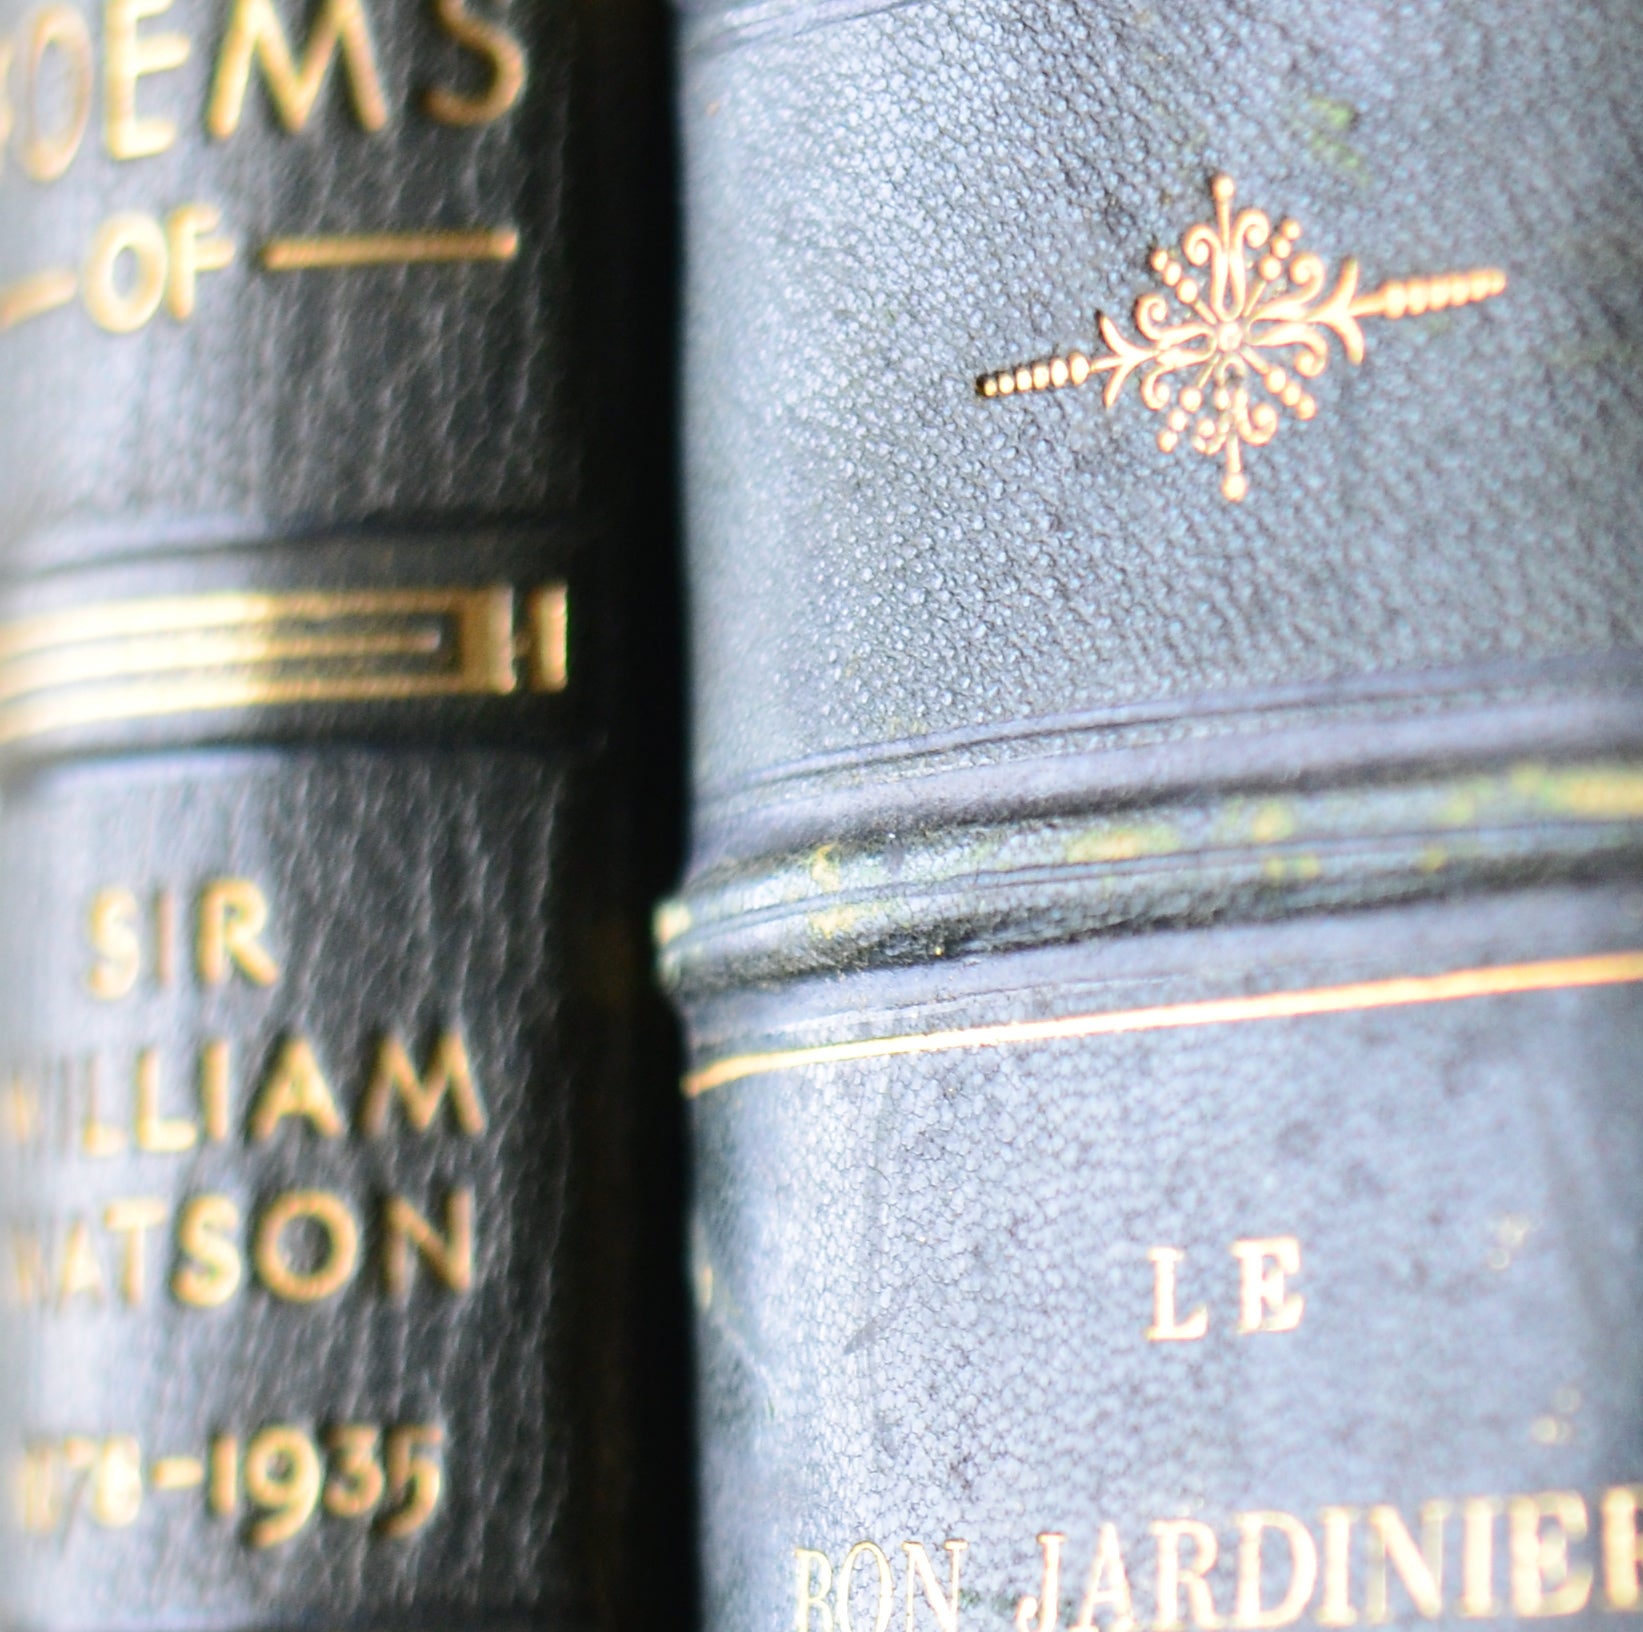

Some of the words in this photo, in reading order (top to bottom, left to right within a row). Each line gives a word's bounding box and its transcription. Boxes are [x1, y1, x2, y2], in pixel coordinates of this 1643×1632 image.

[0, 0, 528, 180] OEMS
[86, 203, 237, 333] OF
[86, 876, 280, 1001] SIR
[1144, 1235, 1306, 1342] LE
